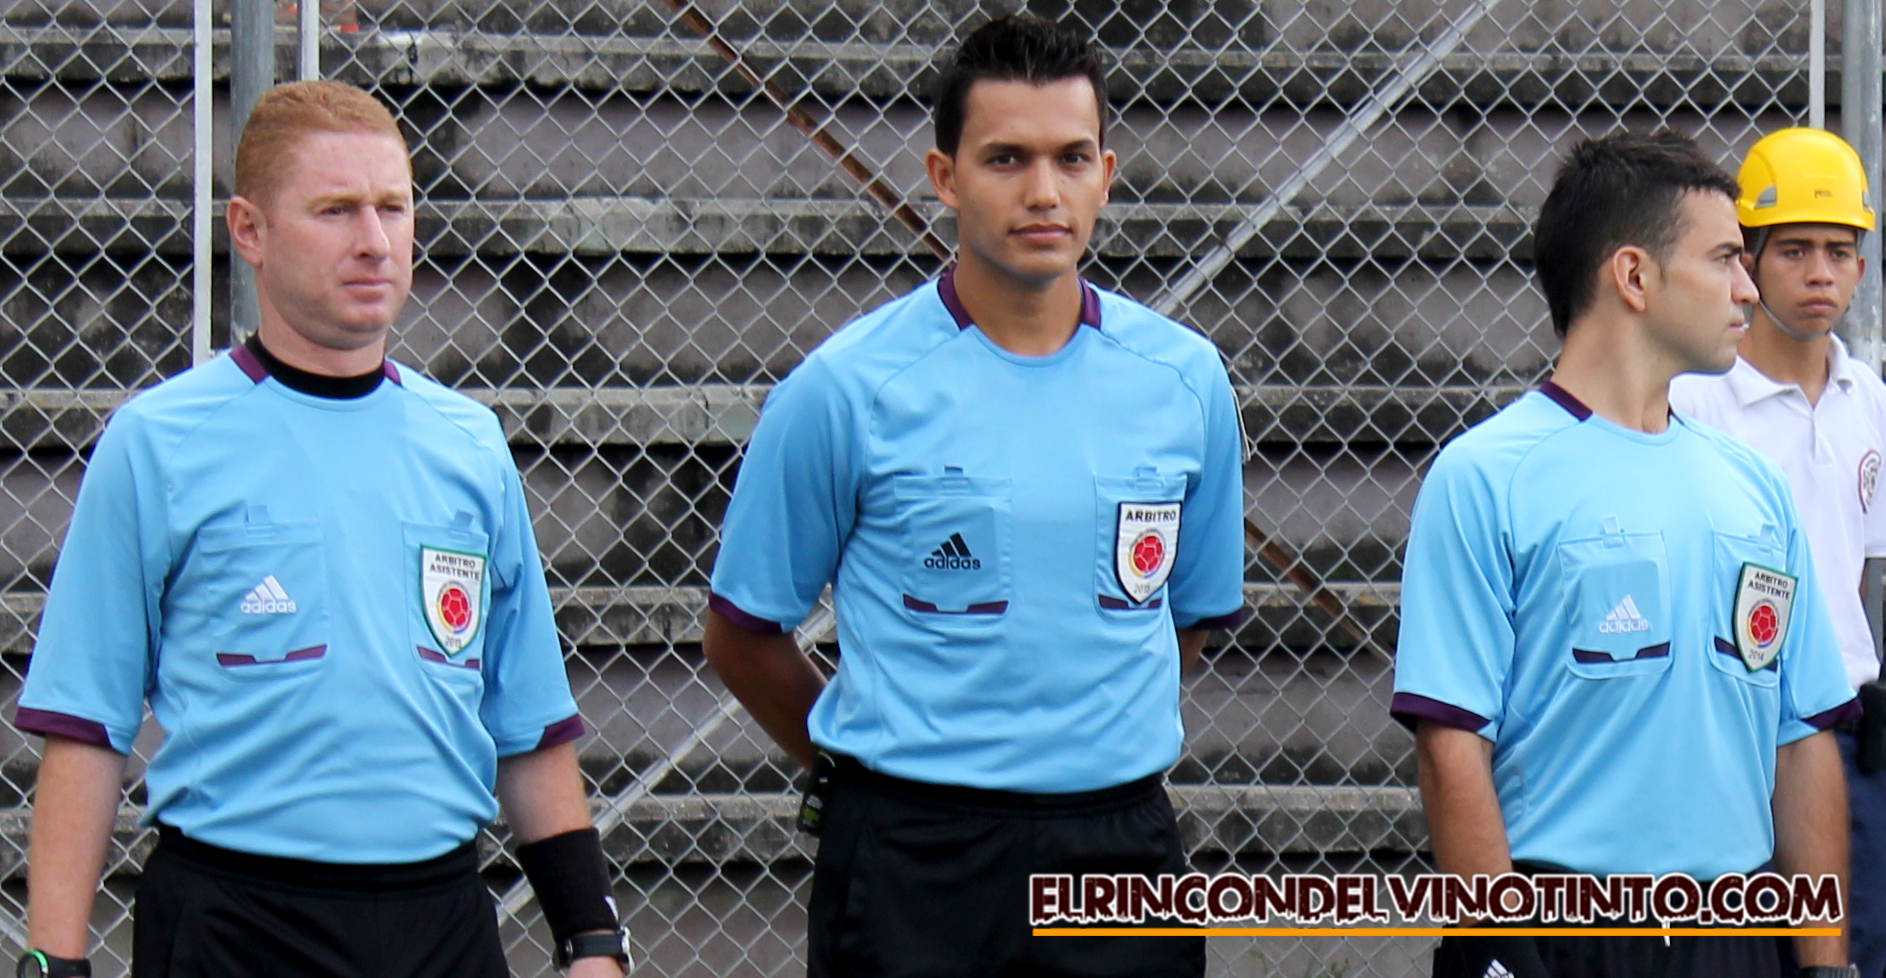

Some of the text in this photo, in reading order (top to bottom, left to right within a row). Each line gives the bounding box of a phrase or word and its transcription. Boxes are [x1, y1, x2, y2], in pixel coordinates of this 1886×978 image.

[1126, 510, 1177, 522] ARBITRO
[434, 553, 476, 569] ARBITRO
[923, 555, 982, 570] adidas
[430, 562, 480, 581] ASISTENTE
[1754, 571, 1788, 589] ARBITRO
[1747, 580, 1791, 600] ASISTENTE
[240, 600, 297, 614] adidas
[1598, 619, 1650, 634] adidas
